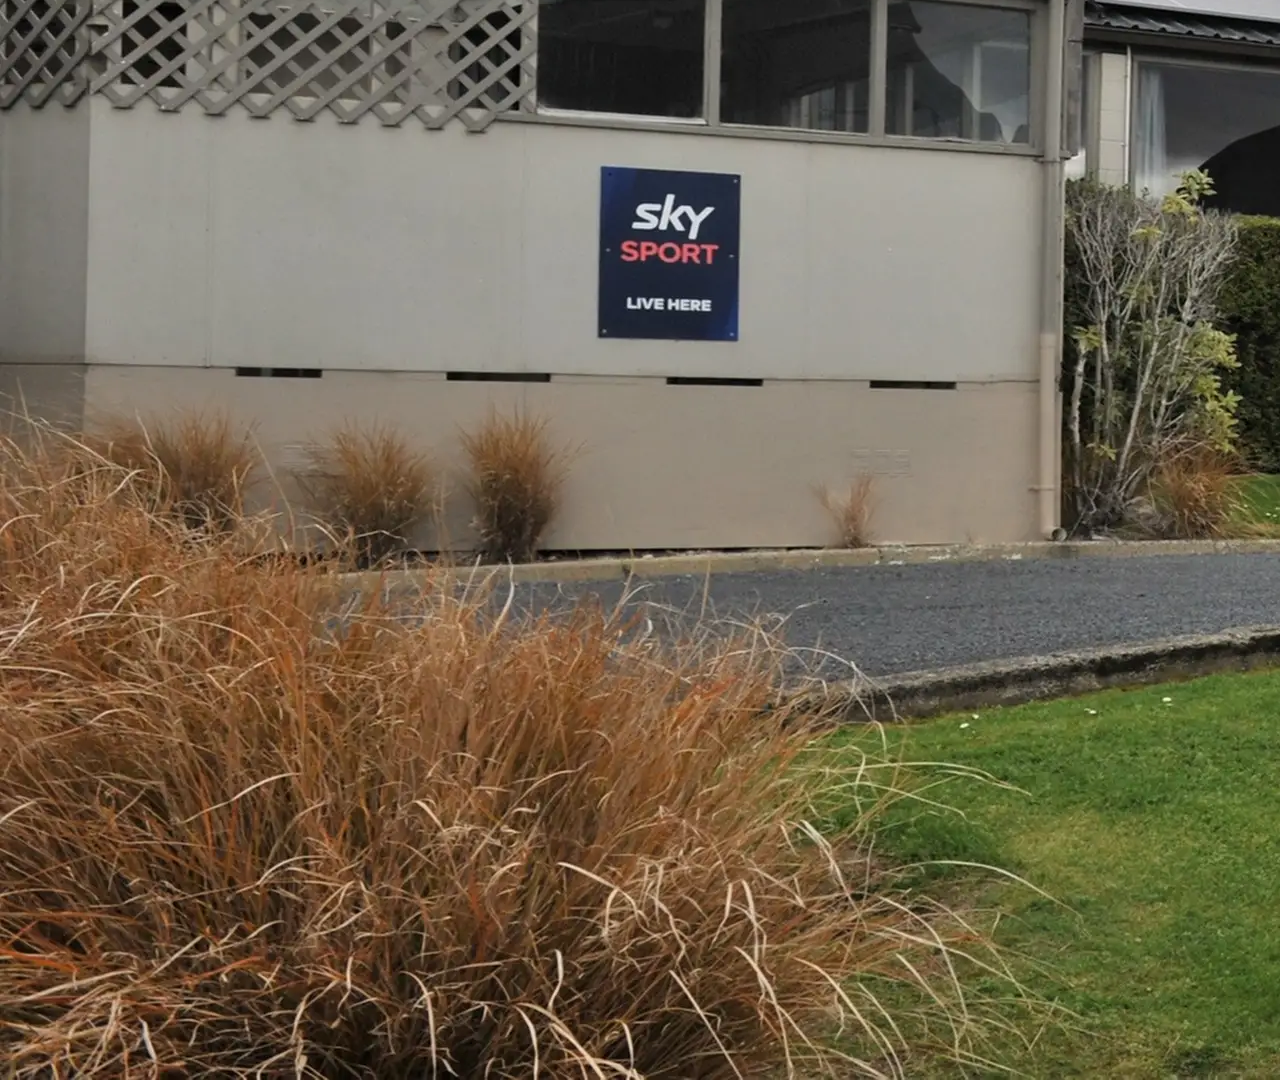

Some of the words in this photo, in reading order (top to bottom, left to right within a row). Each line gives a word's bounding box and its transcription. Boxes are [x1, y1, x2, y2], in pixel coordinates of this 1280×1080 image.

[620, 240, 719, 265] SPORT
[626, 297, 664, 310] LIVE
[667, 298, 712, 312] HERE
